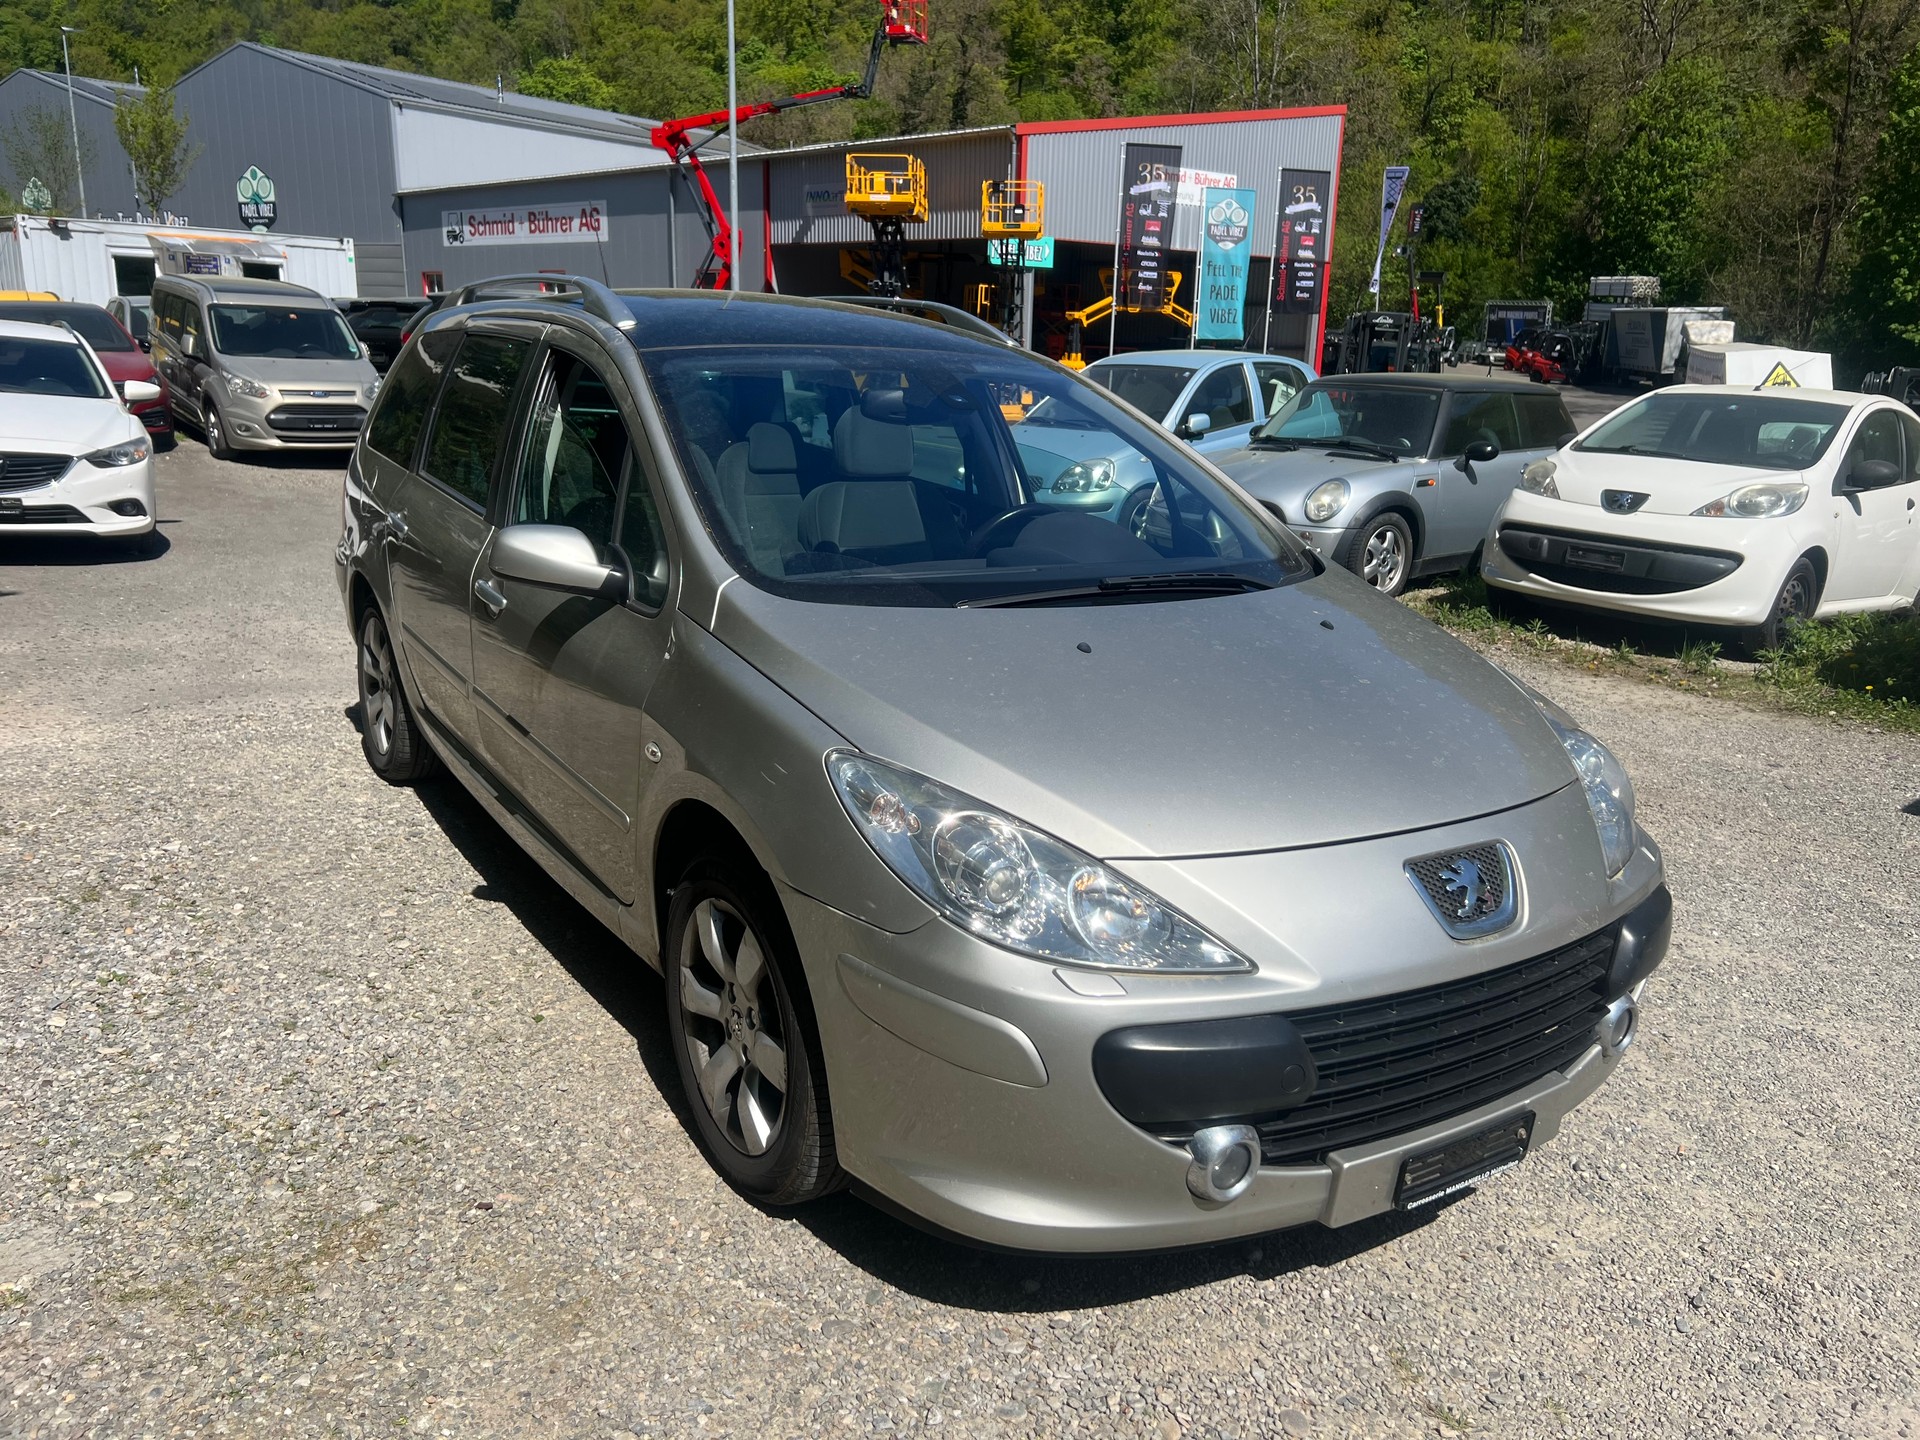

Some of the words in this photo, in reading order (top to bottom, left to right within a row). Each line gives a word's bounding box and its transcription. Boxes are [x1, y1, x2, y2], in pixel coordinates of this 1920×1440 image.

[1137, 163, 1165, 184] 35
[1194, 172, 1220, 187] Bührer
[1223, 176, 1235, 188] AG
[1291, 185, 1316, 205] 35
[241, 203, 258, 217] PADEL
[258, 203, 274, 217] VIBEZ
[1126, 203, 1135, 217] AG
[468, 213, 515, 237] Schmid
[528, 211, 574, 234] Bührer
[579, 207, 601, 232] AG
[1282, 220, 1291, 234] AG
[1210, 225, 1227, 236] PADEL
[1229, 226, 1244, 237] VIBEZ
[1280, 235, 1290, 263] Bührer
[1207, 261, 1226, 277] FEEL
[1210, 285, 1239, 301] PADEL
[1276, 270, 1287, 300] Schmid
[1210, 308, 1238, 324] VIBEZ
[1407, 1190, 1445, 1210] Carrosserie
[1446, 1171, 1491, 1195] MANGANIELLO
